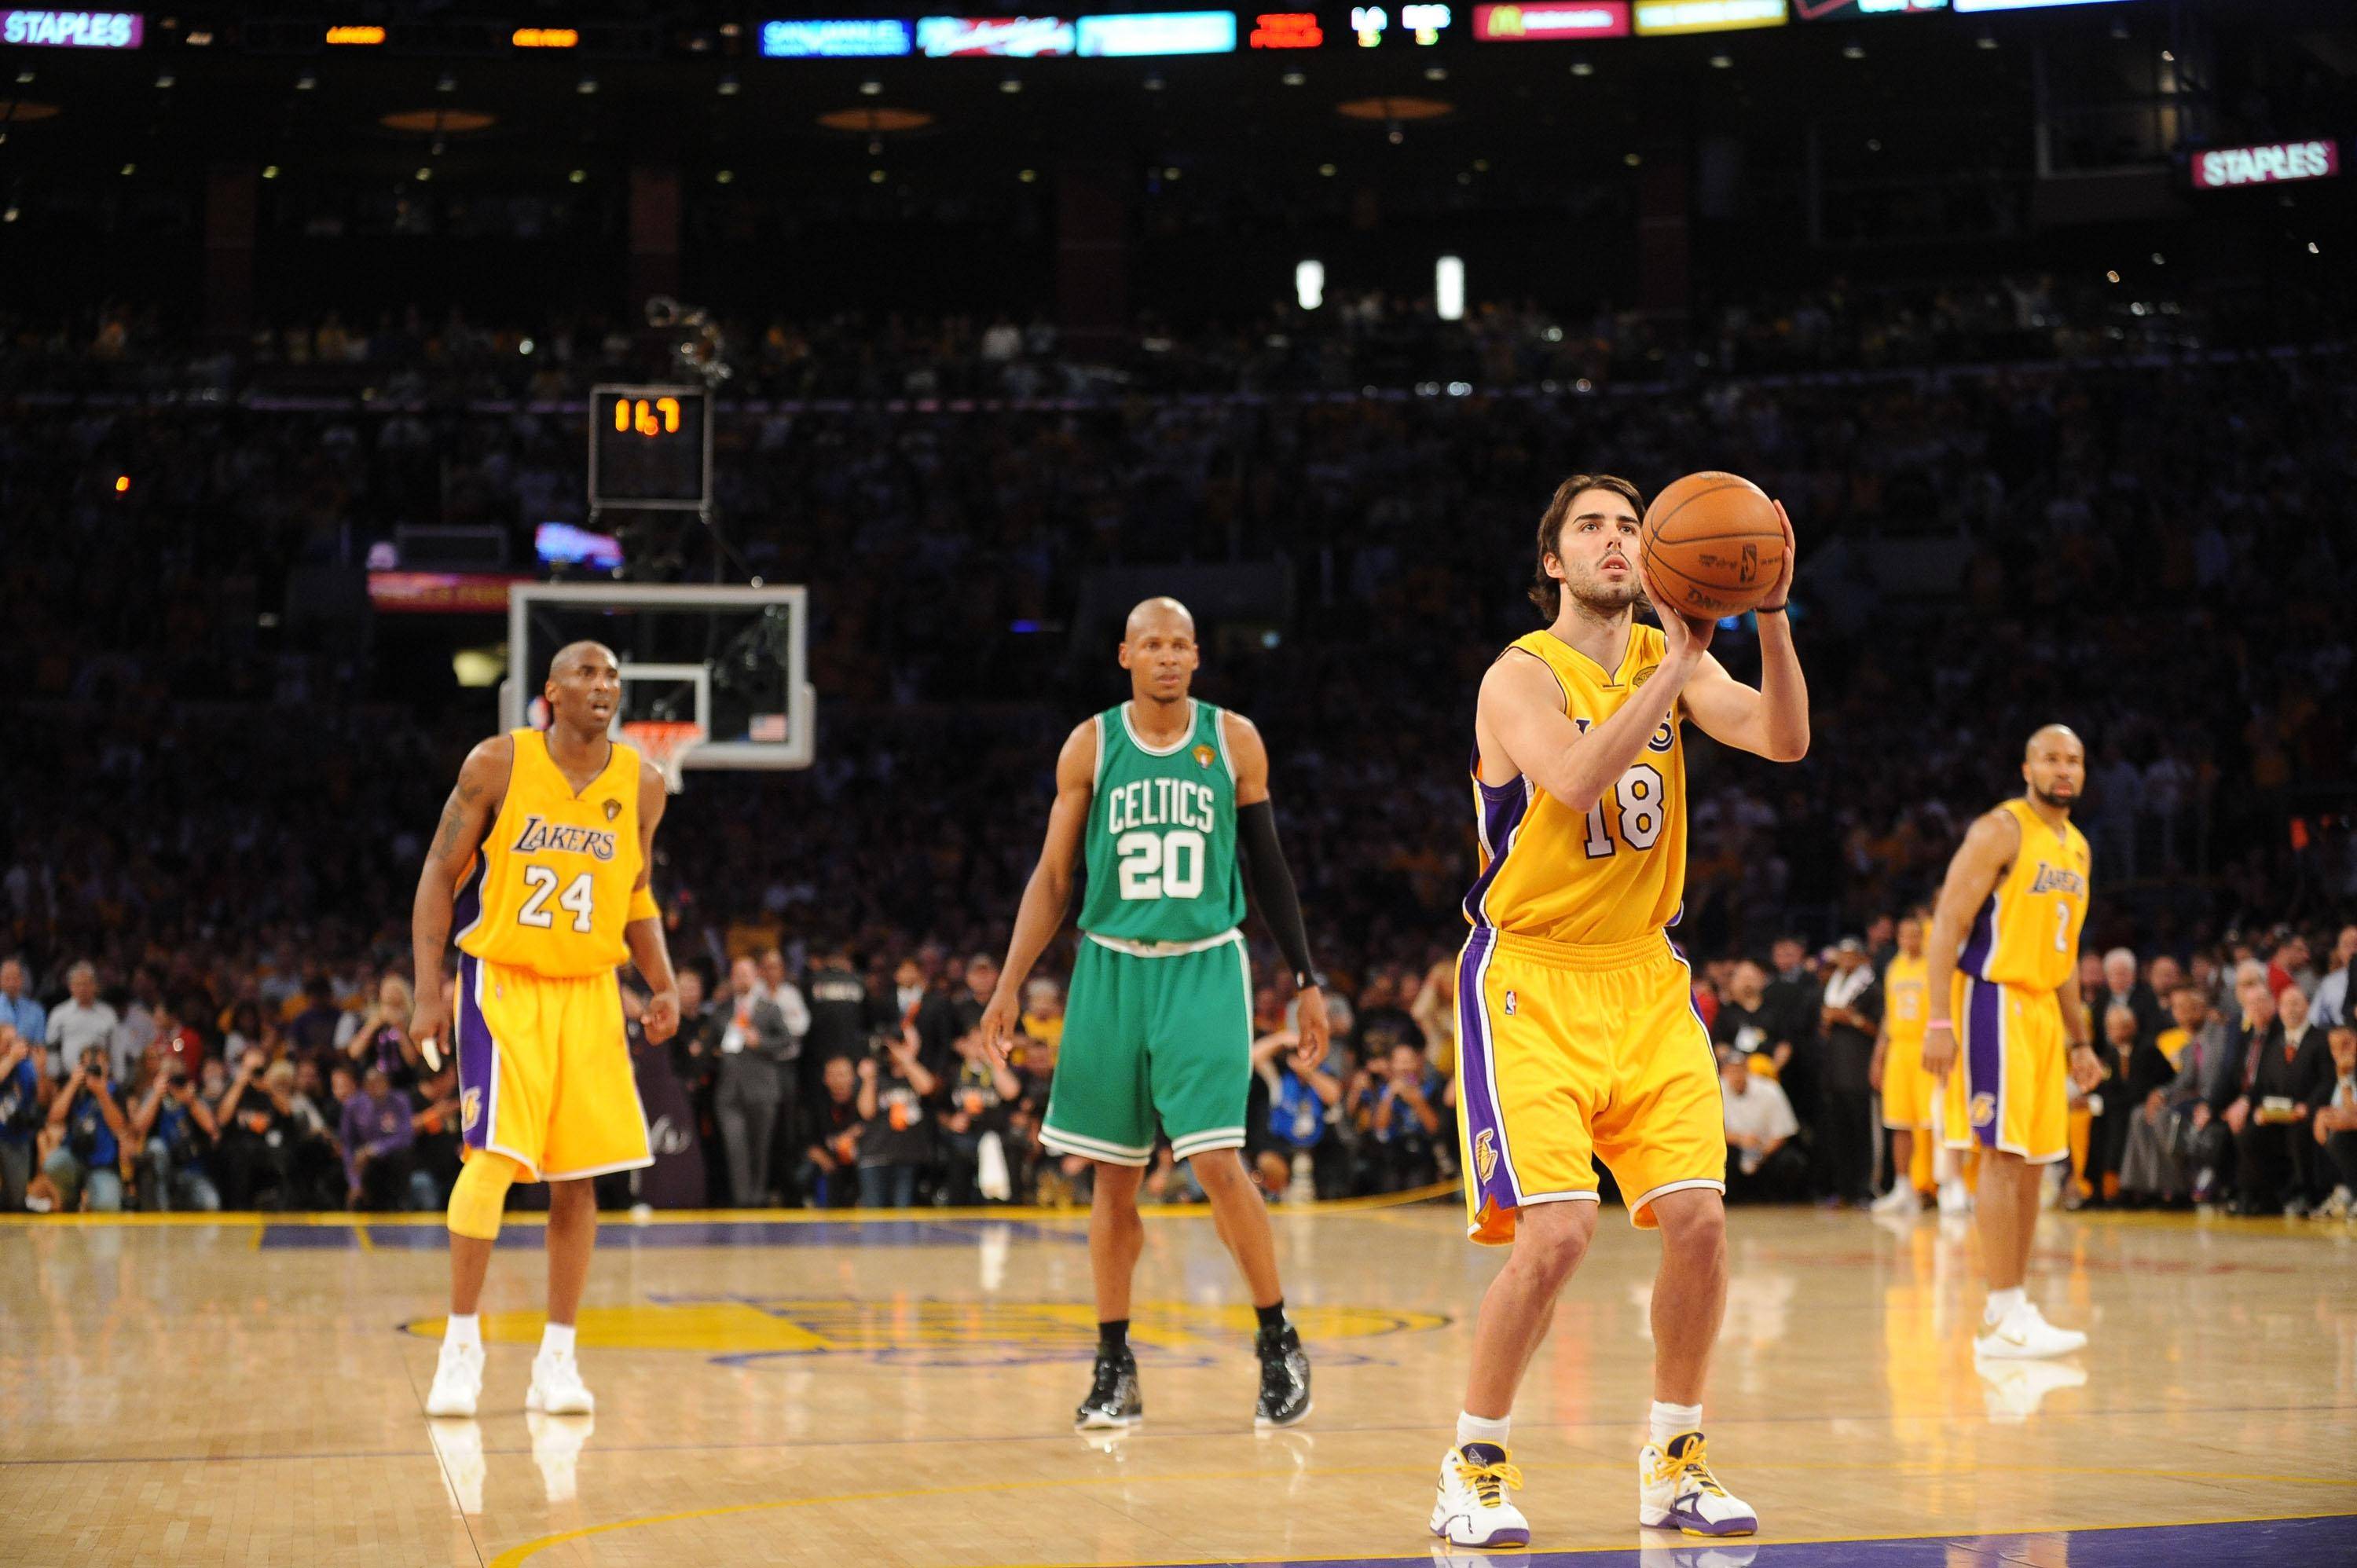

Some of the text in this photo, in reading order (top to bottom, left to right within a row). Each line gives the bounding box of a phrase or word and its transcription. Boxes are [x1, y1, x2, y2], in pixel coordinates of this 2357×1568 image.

[4, 10, 132, 47] STAPLES
[2203, 141, 2329, 186] STAPLES
[1109, 777, 1215, 835] CELTICS
[1584, 763, 1665, 859] 18
[511, 815, 615, 861] LAKERS
[1116, 830, 1206, 900] 20
[517, 864, 594, 933] 24
